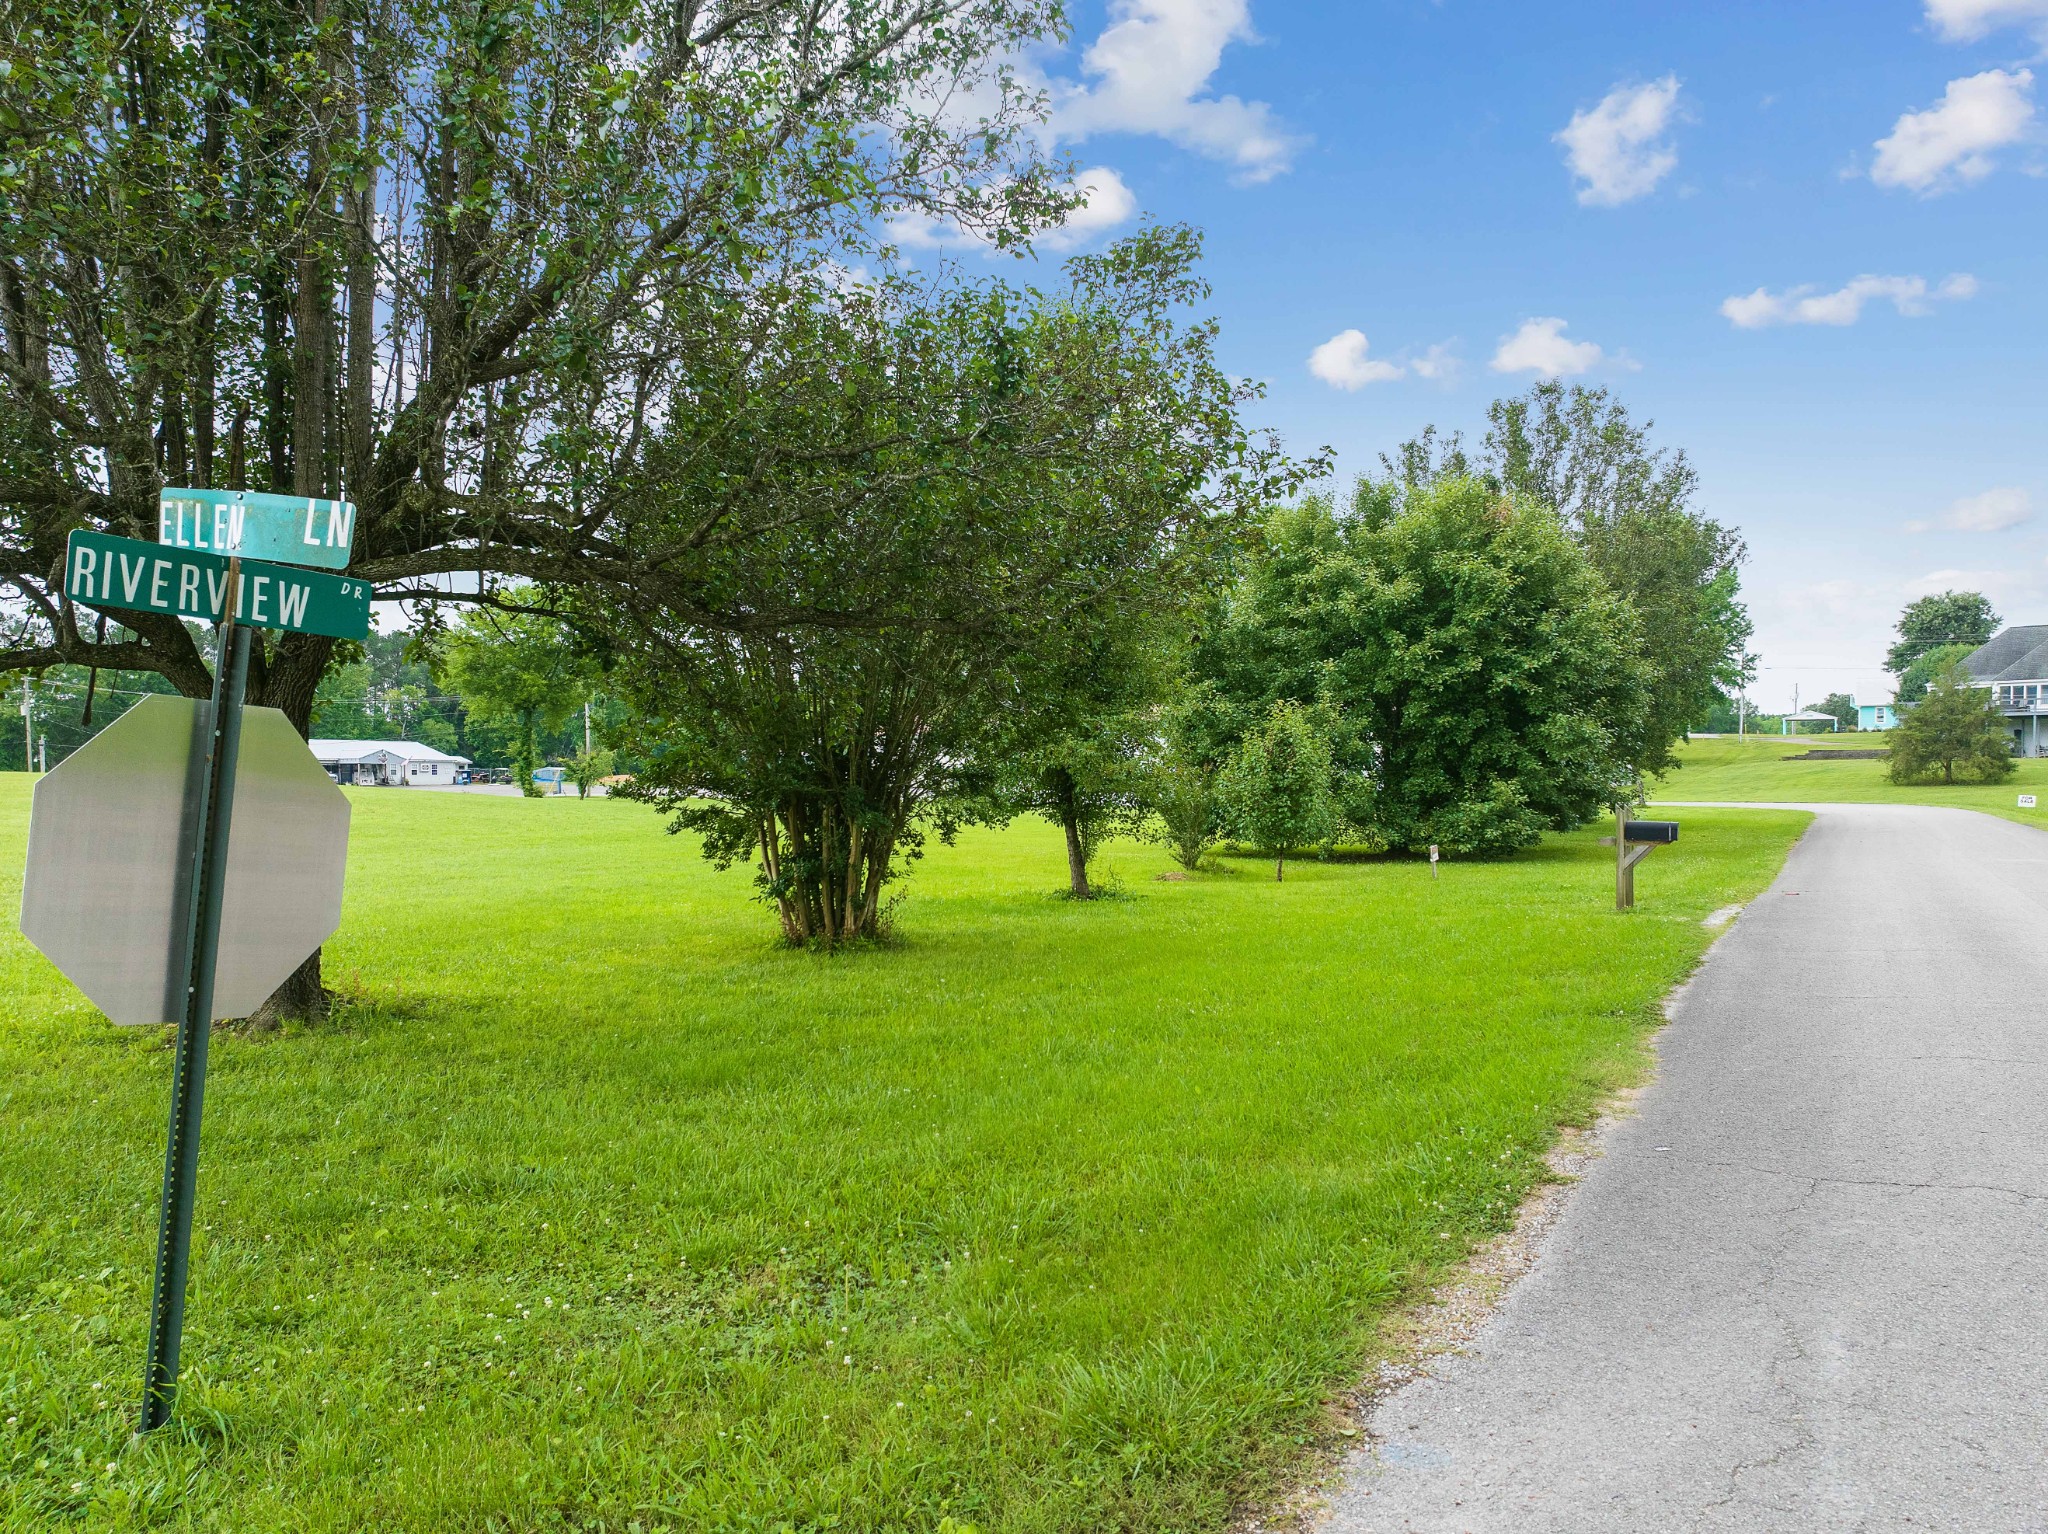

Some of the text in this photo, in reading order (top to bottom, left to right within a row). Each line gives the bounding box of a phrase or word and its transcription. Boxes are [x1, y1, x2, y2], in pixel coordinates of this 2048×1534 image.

[159, 499, 352, 550] ELLEN LN
[71, 546, 362, 627] RIVERVIEW DR
